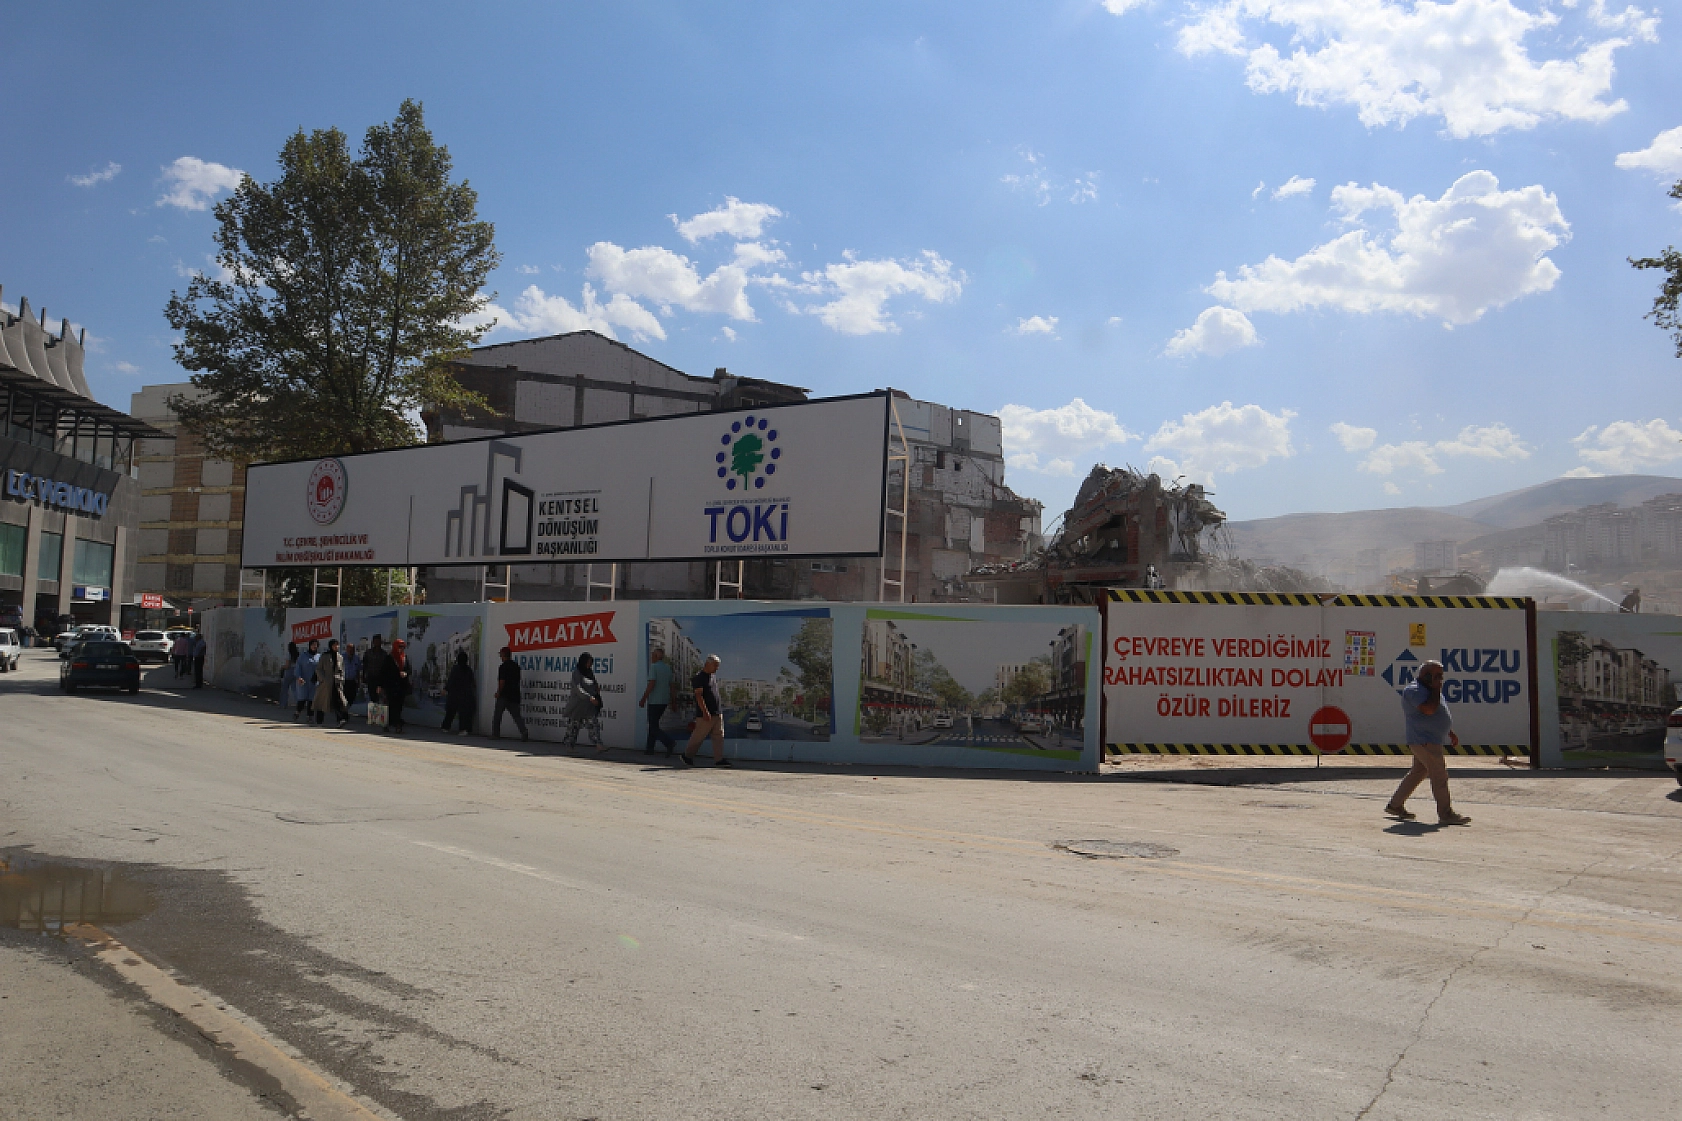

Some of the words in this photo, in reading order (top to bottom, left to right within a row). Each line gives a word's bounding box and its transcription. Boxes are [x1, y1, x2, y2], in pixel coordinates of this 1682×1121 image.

[538, 498, 599, 516] KENTSEL
[537, 516, 599, 540] DÖNÜŞÜM
[537, 536, 598, 559] BAŞKANLIĞI
[293, 620, 329, 640] MALATYA
[514, 619, 604, 646] MALATYA
[1113, 636, 1206, 661] ÇEVREYE
[1211, 633, 1331, 658] VERDİĞİMİZ
[1440, 648, 1520, 673] KUZU
[1104, 666, 1264, 687] RAHATSIZLIKTAN
[1271, 668, 1344, 688] DOLAYI
[1441, 679, 1521, 703] GRUP
[1157, 693, 1211, 718] ÖZÜR
[1218, 694, 1291, 718] DİLERİZ
